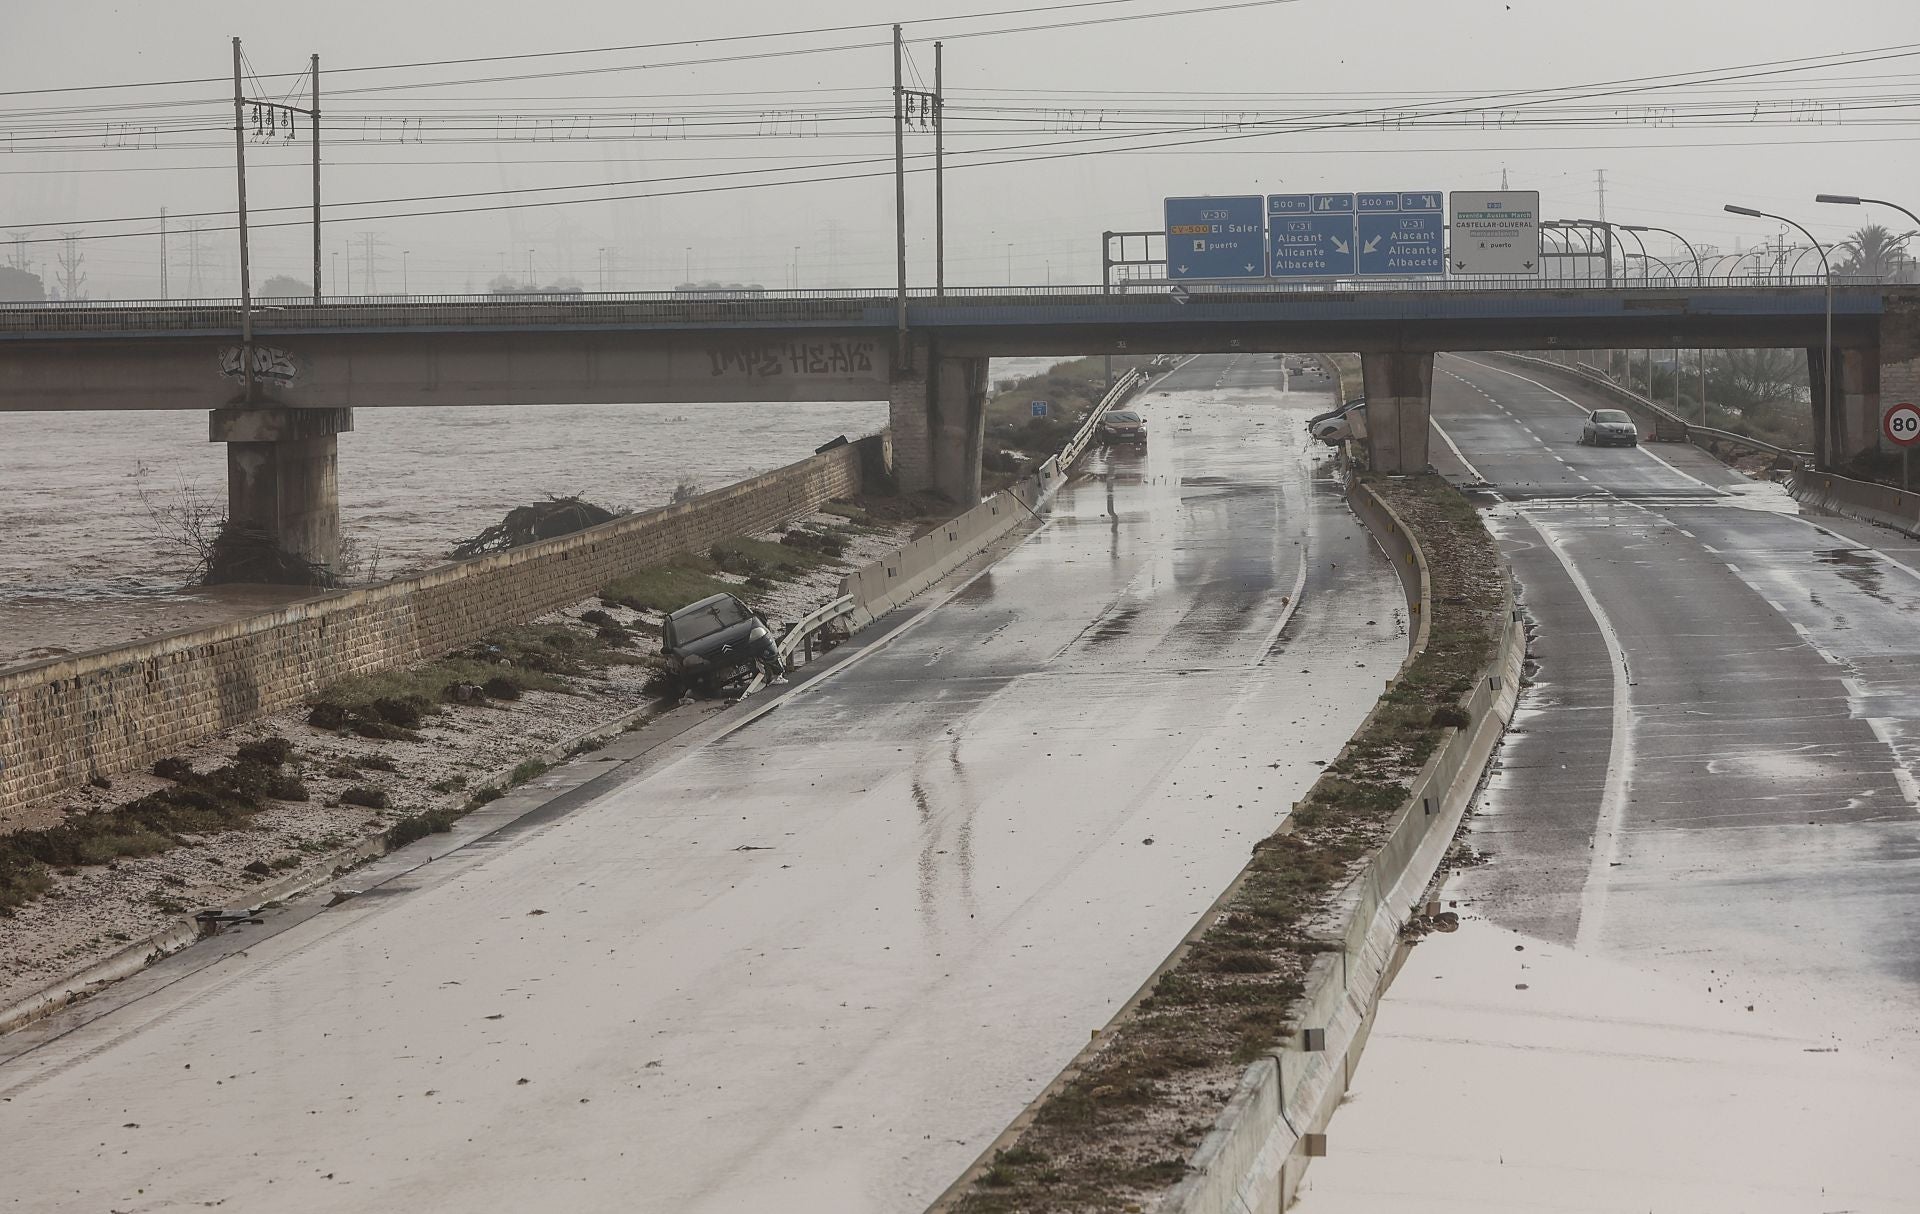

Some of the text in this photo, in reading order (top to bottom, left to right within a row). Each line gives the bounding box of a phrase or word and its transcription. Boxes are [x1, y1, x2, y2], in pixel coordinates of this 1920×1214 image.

[1273, 200, 1293, 208] 500
[1361, 198, 1382, 206] 500
[1407, 198, 1413, 206] 3
[1202, 211, 1227, 219] V-30
[1171, 224, 1259, 233] CV-500 El Saler
[1289, 222, 1310, 230] V-31
[1402, 220, 1423, 228] V-31
[1278, 233, 1322, 242] Alacant
[1390, 231, 1435, 240] Alacant
[1209, 241, 1238, 250] puerto
[1276, 247, 1325, 257] Alicante
[1388, 246, 1437, 255] Alicante
[1276, 260, 1326, 269] Albacete
[1388, 258, 1438, 267] Albacete
[1892, 417, 1918, 432] 80
